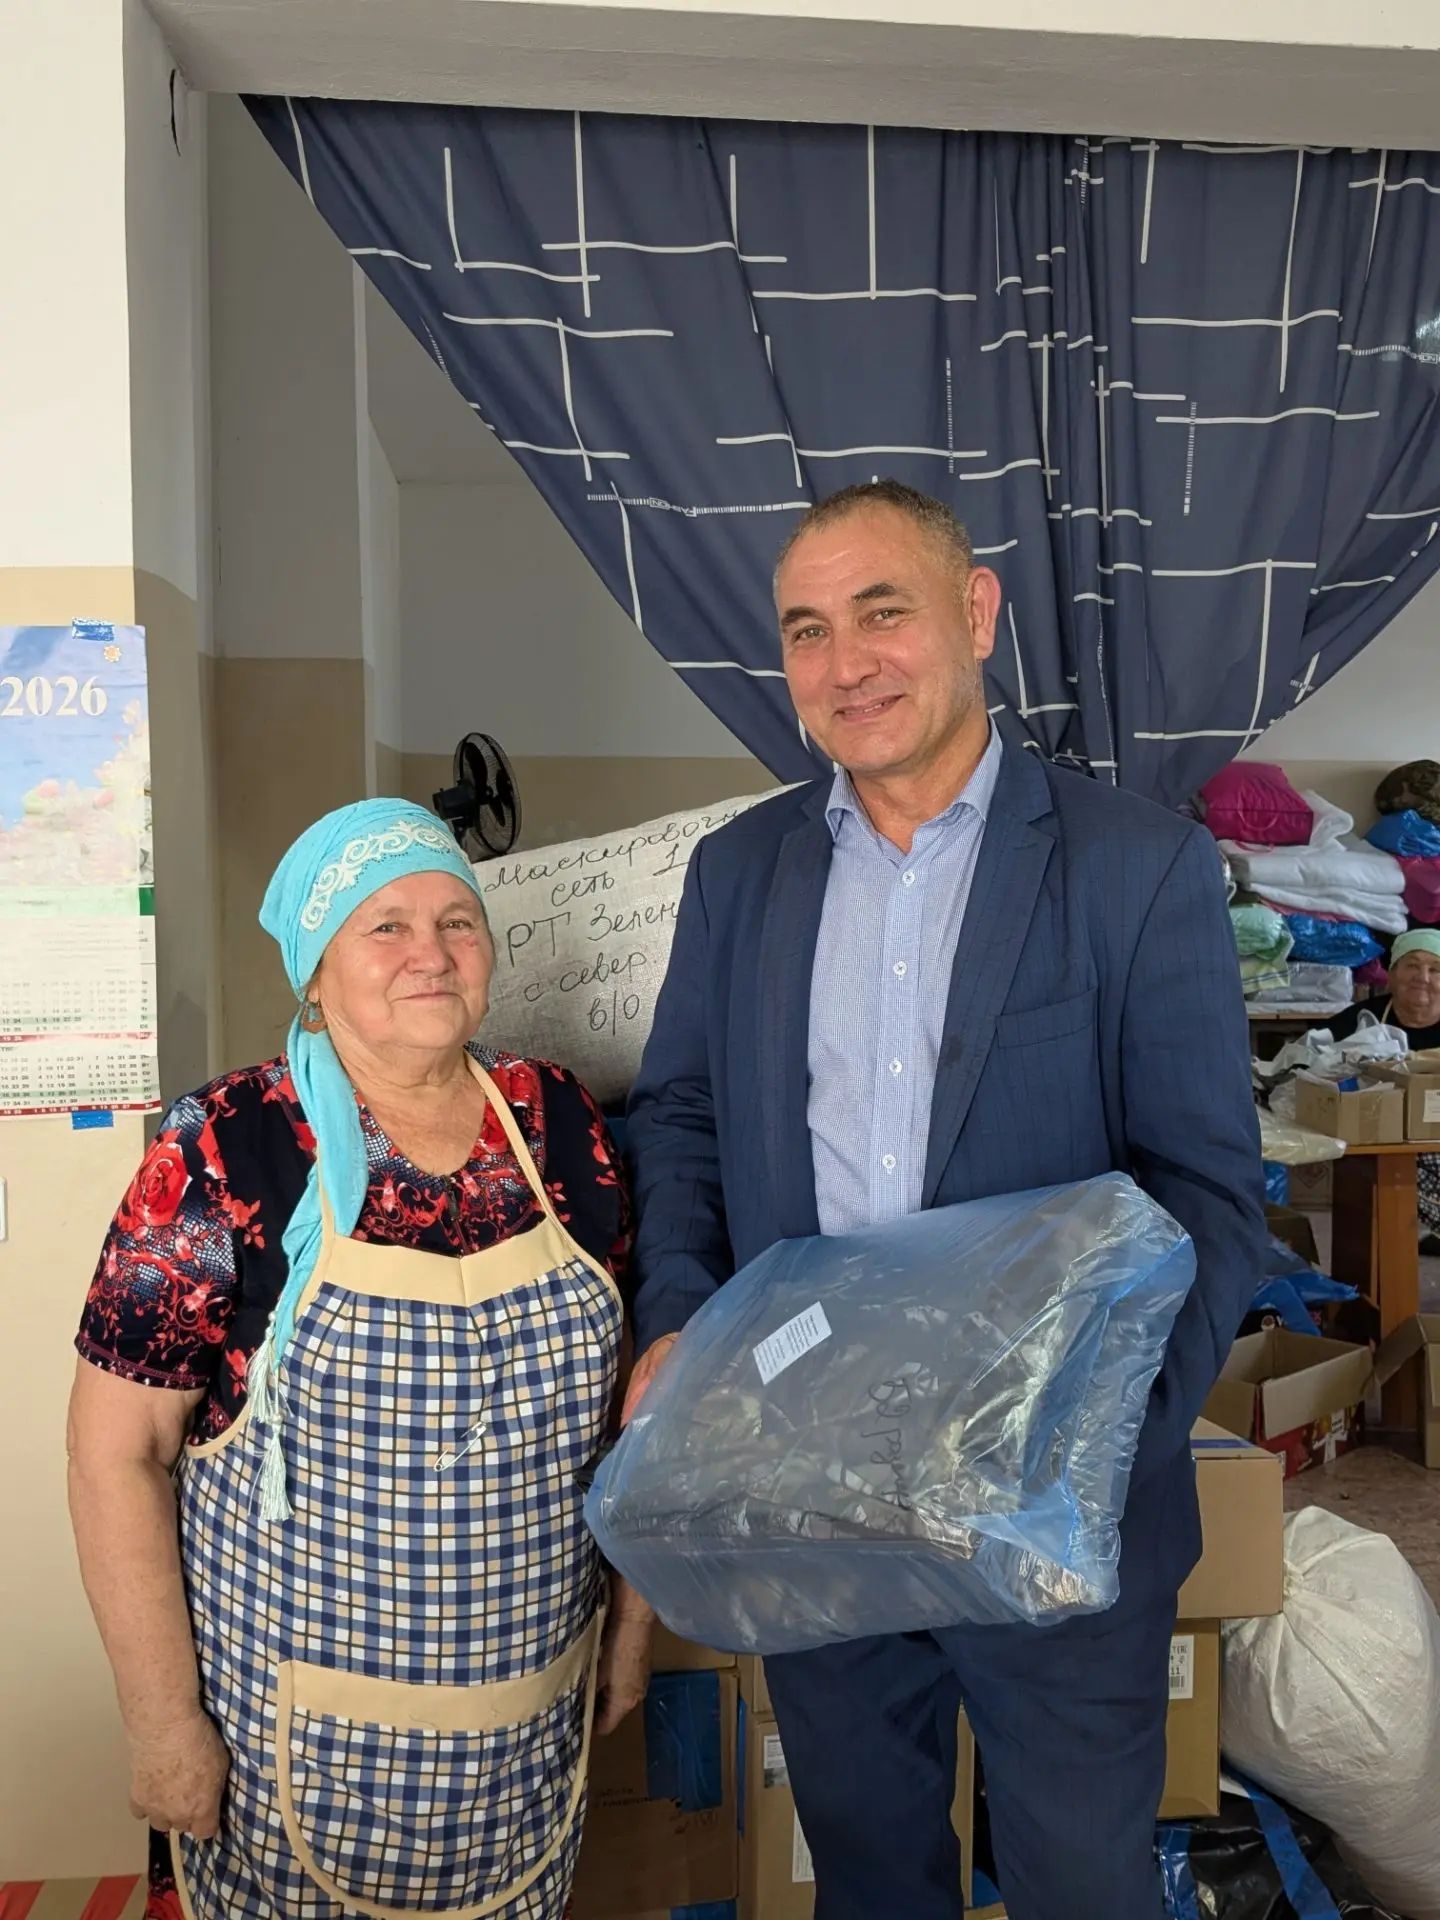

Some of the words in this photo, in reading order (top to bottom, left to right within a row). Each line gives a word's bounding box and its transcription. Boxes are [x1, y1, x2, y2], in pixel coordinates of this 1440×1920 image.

[0, 675, 108, 717] 2026
[484, 803, 759, 892] Маскировочн
[588, 903, 678, 941] Зелен
